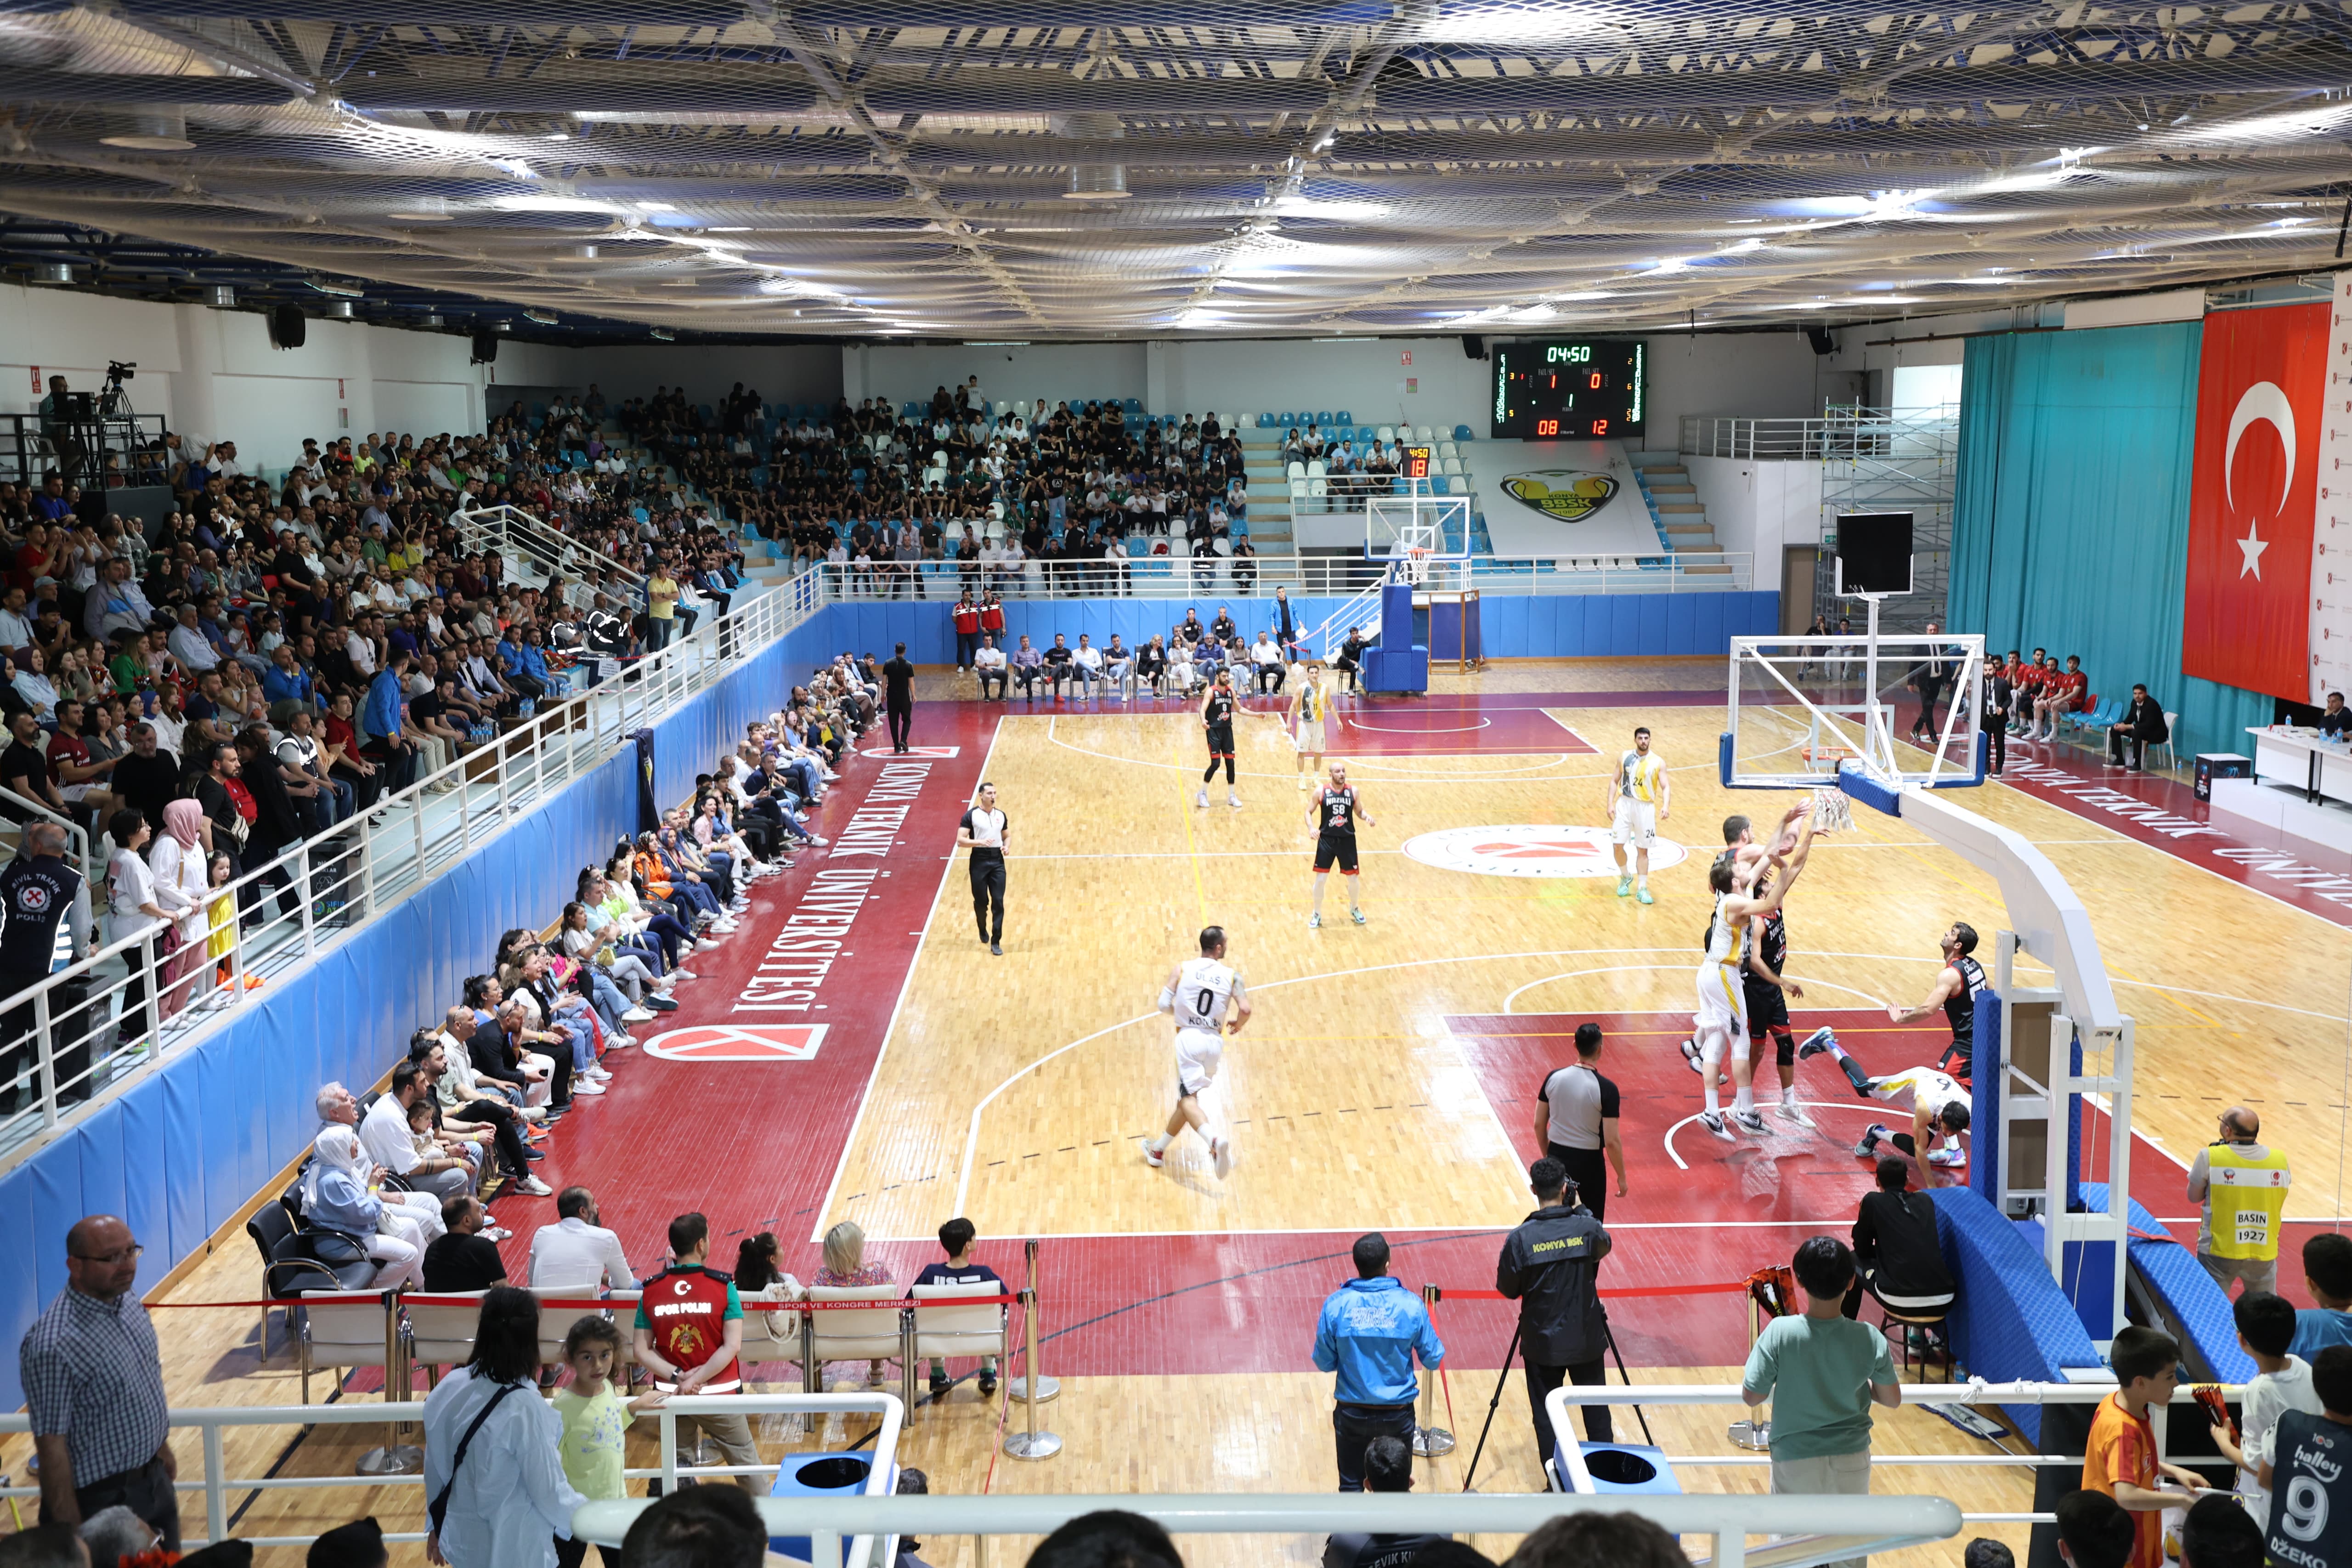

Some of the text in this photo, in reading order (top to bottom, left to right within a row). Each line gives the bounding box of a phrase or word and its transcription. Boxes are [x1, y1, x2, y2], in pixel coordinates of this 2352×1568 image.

[1547, 347, 1590, 362] 04:50
[1552, 375, 1556, 388] 1
[1591, 374, 1600, 388] 0
[1569, 394, 1573, 407] 1
[1538, 420, 1558, 435] 08
[1593, 420, 1607, 435] 12
[1409, 448, 1428, 458] 4:50
[1411, 460, 1425, 476] 18
[1541, 498, 1593, 508] BBSK
[1222, 703, 1227, 712] 8
[1633, 777, 1642, 787] 24
[1332, 804, 1345, 815] 58
[2059, 787, 2230, 838] TEKNİK
[1646, 829, 1655, 838] 24
[731, 762, 933, 1013] KONYA TEKNİK ÜNİVERSİTESİ
[1196, 972, 1221, 985] ULAŞ
[1197, 988, 1213, 1016] 0
[2238, 1214, 2266, 1224] BASIN
[2239, 1231, 2265, 1241] 1927
[1533, 1240, 1566, 1253] KONYA
[875, 1299, 921, 1308] MERKEZİ
[655, 1304, 679, 1317] SPOR
[2295, 1444, 2342, 1483] halley
[2282, 1476, 2329, 1541] 9
